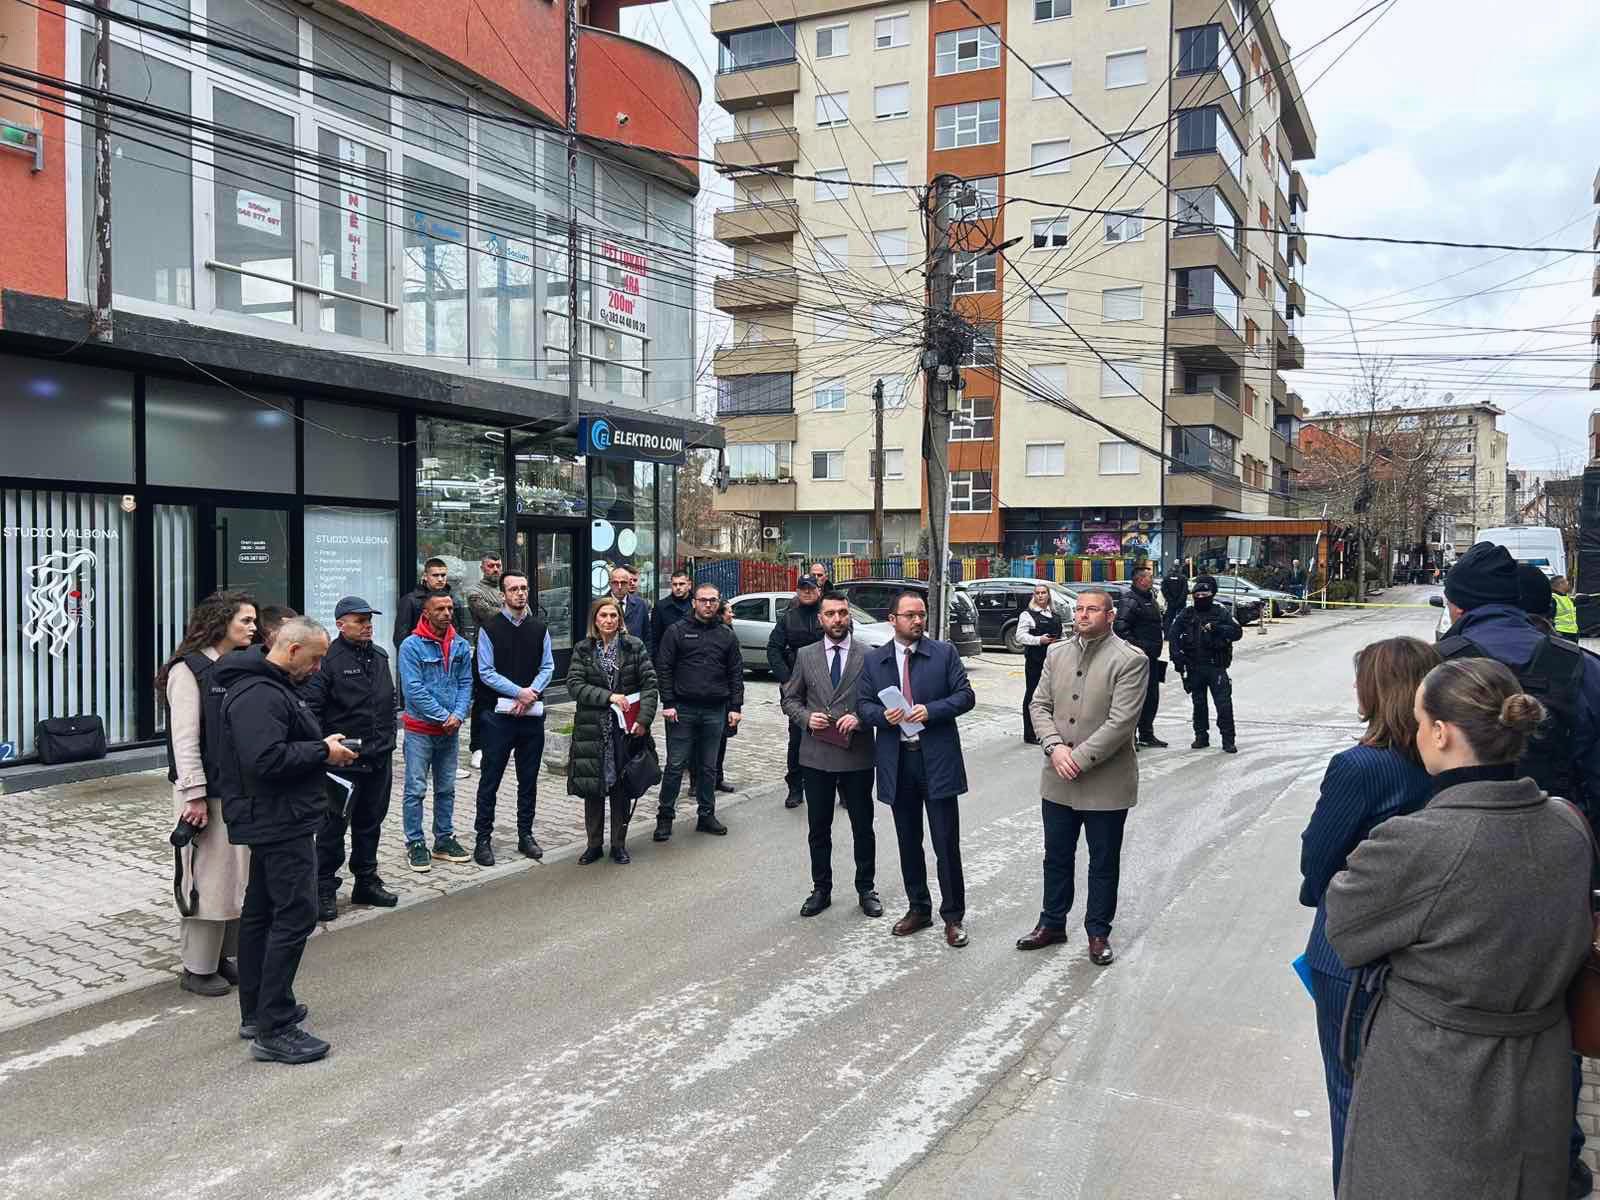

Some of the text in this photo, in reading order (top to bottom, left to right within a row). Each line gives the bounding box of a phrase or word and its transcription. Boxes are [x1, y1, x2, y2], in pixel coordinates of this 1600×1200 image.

[614, 430, 683, 452] ELEKTRO LONI
[3, 527, 119, 539] STUDIO VALBONA
[315, 534, 390, 546] STUDIO VALBONA
